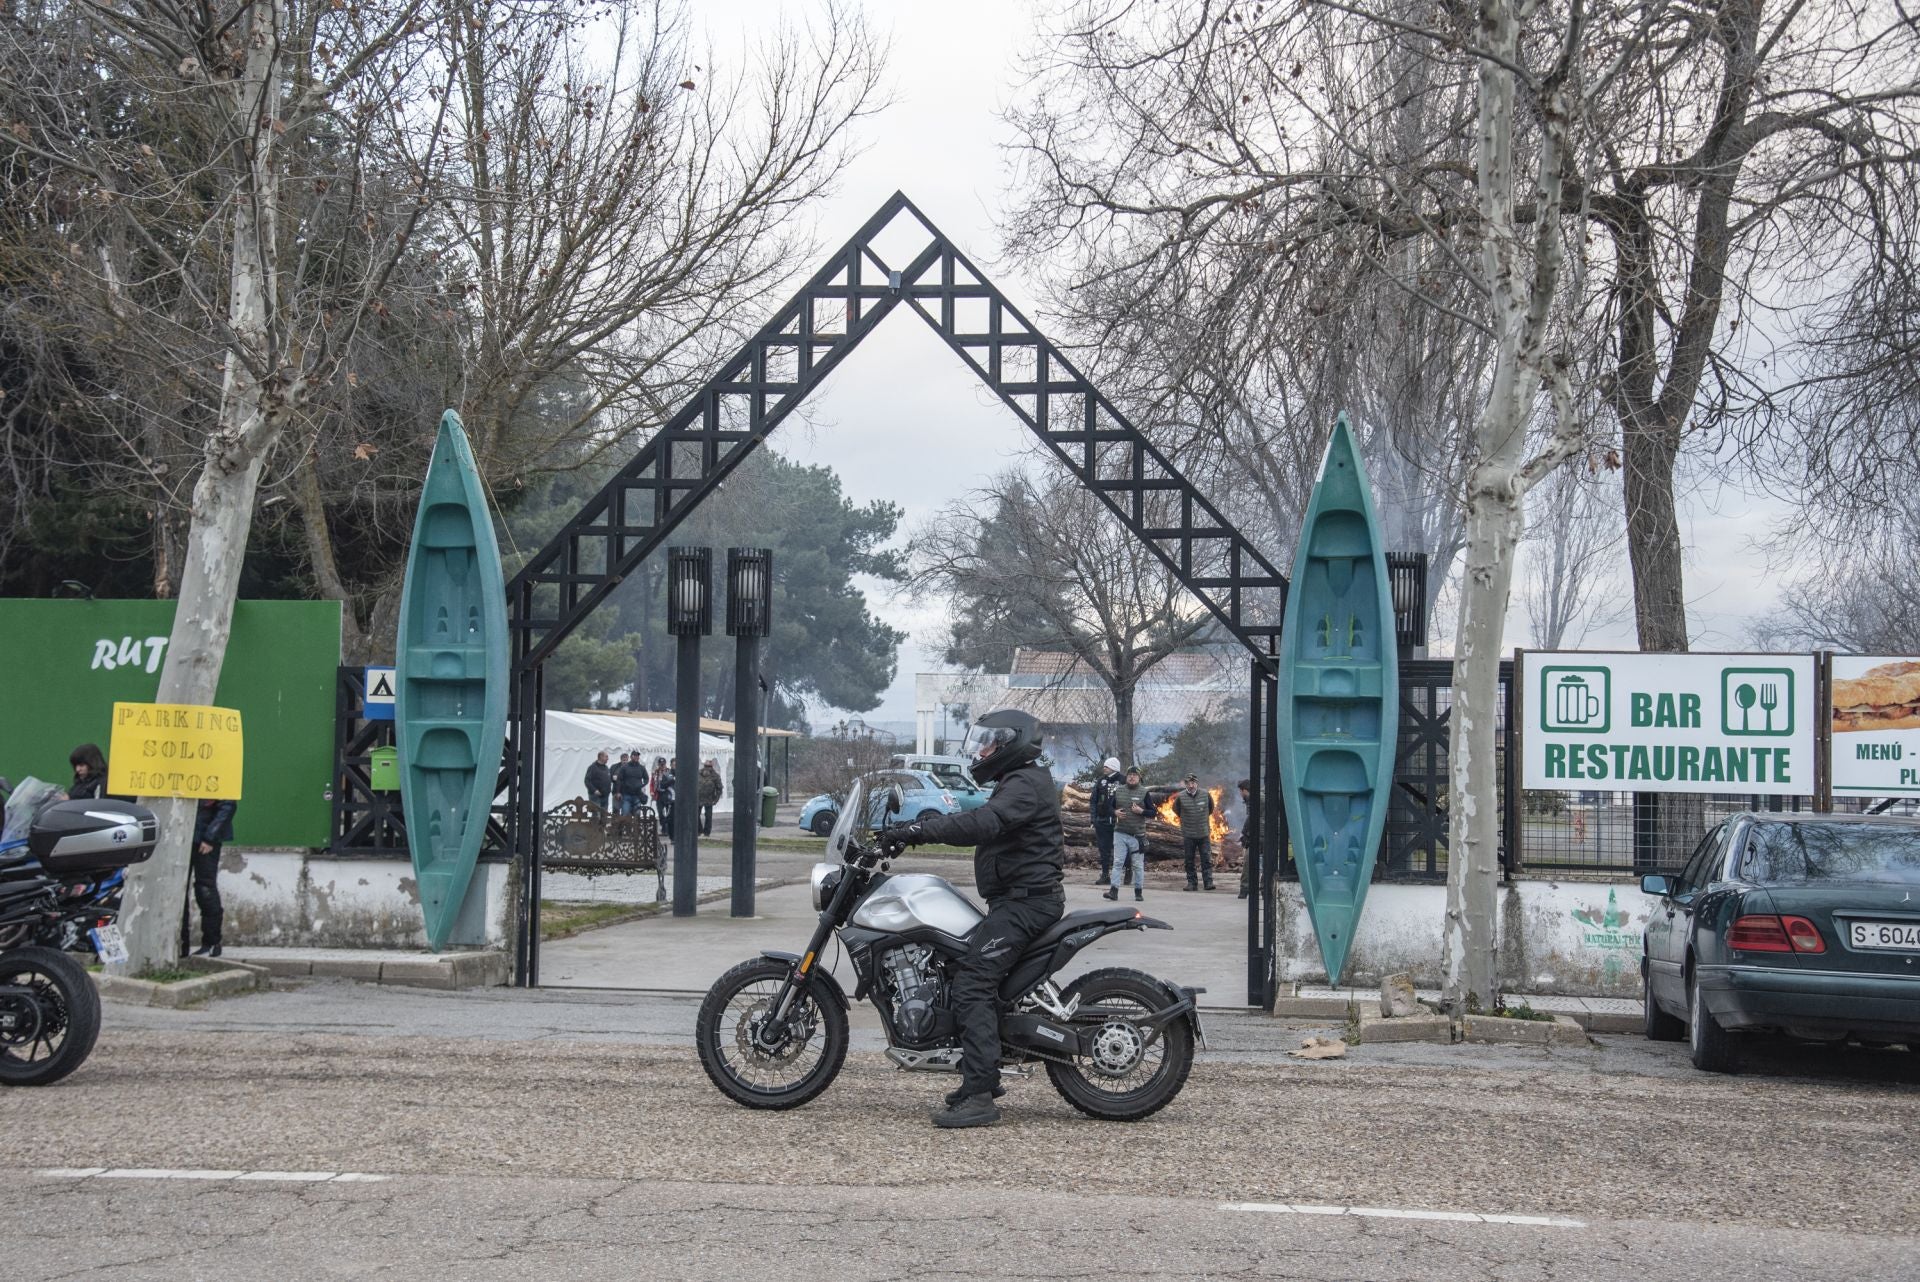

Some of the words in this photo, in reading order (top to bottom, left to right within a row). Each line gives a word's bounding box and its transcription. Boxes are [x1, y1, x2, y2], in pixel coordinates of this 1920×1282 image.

[91, 636, 169, 674] RUT
[118, 707, 239, 732] PARKING
[1630, 692, 1702, 728] BAR
[143, 739, 214, 760] SOLO
[1856, 741, 1902, 761] MENÚ
[1544, 743, 1792, 784] RESTAURANTE
[129, 770, 220, 793] MOTOS
[1900, 768, 1920, 785] PL
